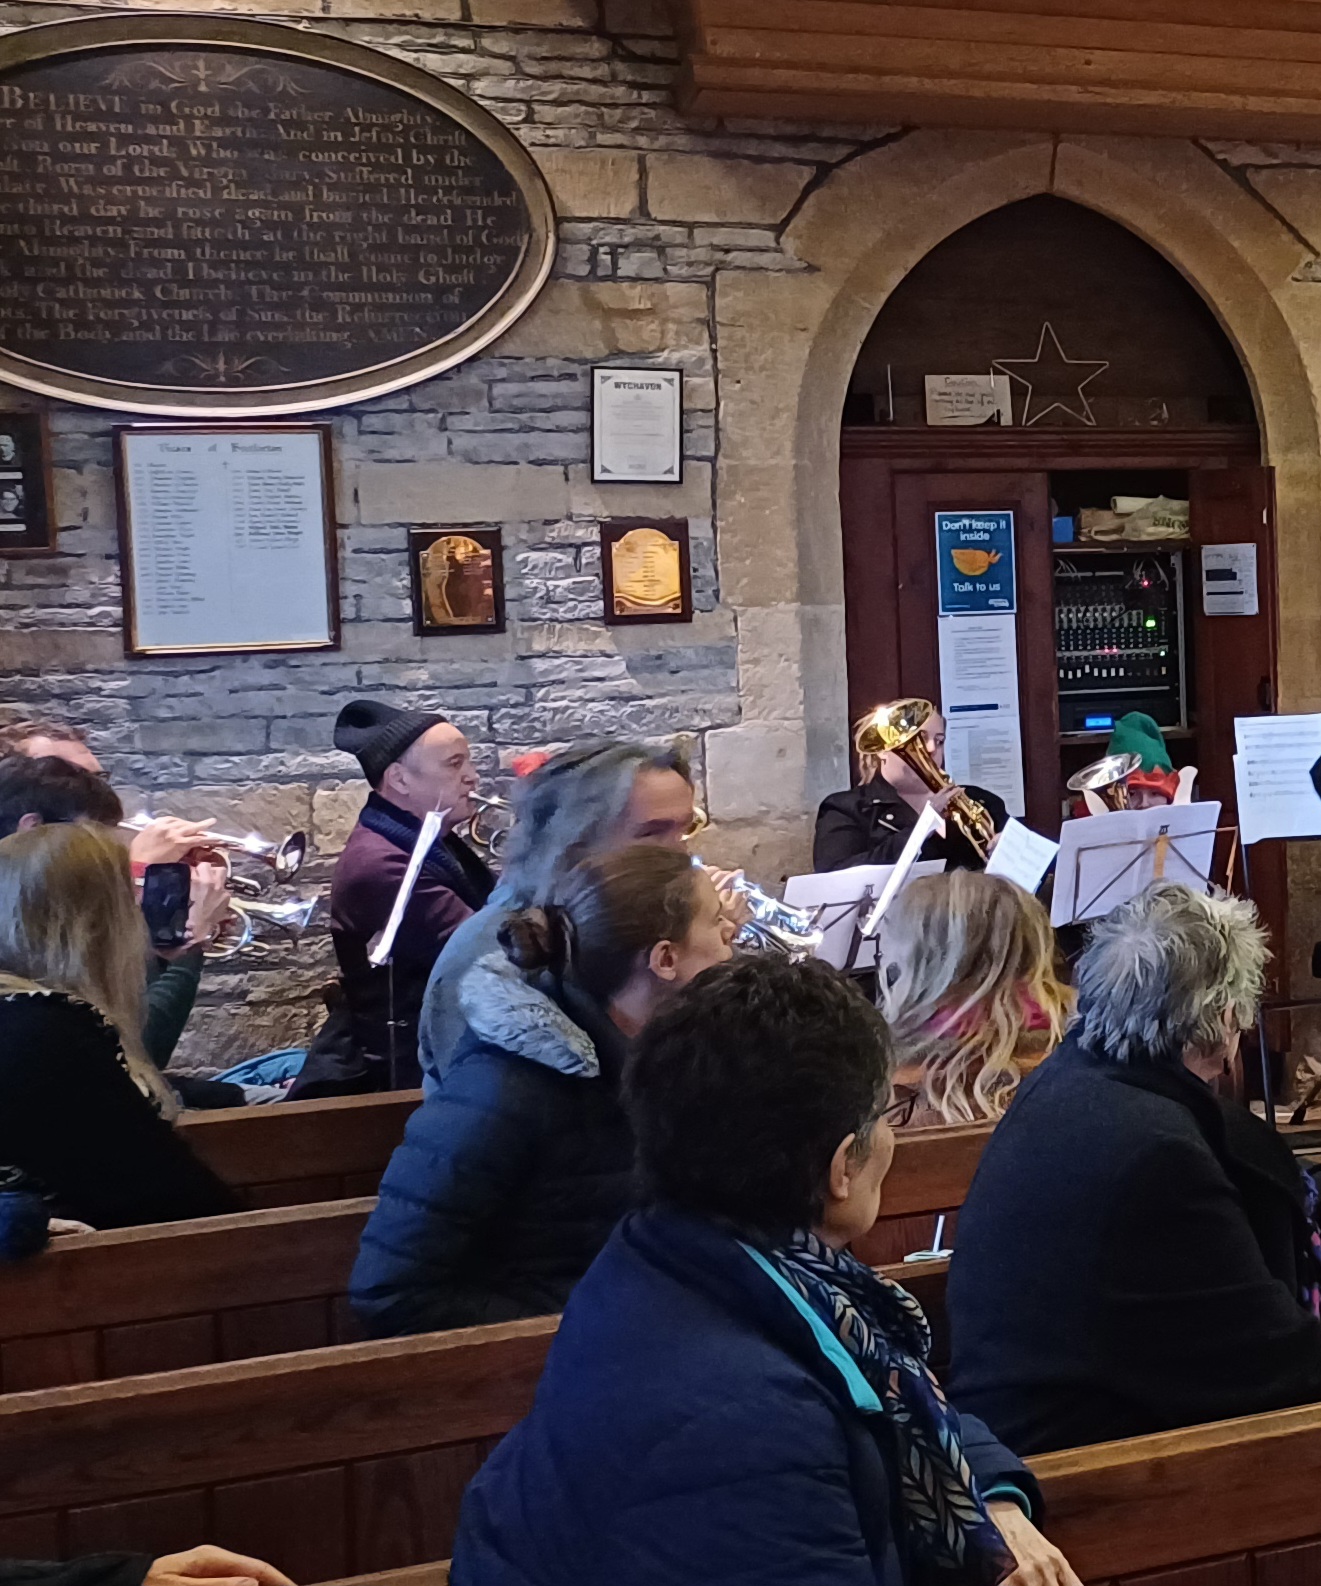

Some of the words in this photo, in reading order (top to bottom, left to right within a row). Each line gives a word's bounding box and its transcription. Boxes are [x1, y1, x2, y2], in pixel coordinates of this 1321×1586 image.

[171, 100, 220, 117] God
[267, 103, 333, 122] Father
[59, 142, 100, 154] our
[300, 146, 402, 164] conceived
[412, 149, 438, 168] by
[960, 531, 990, 541] inside
[953, 582, 973, 592] Talk
[976, 582, 986, 592] to
[989, 583, 1000, 591] us
